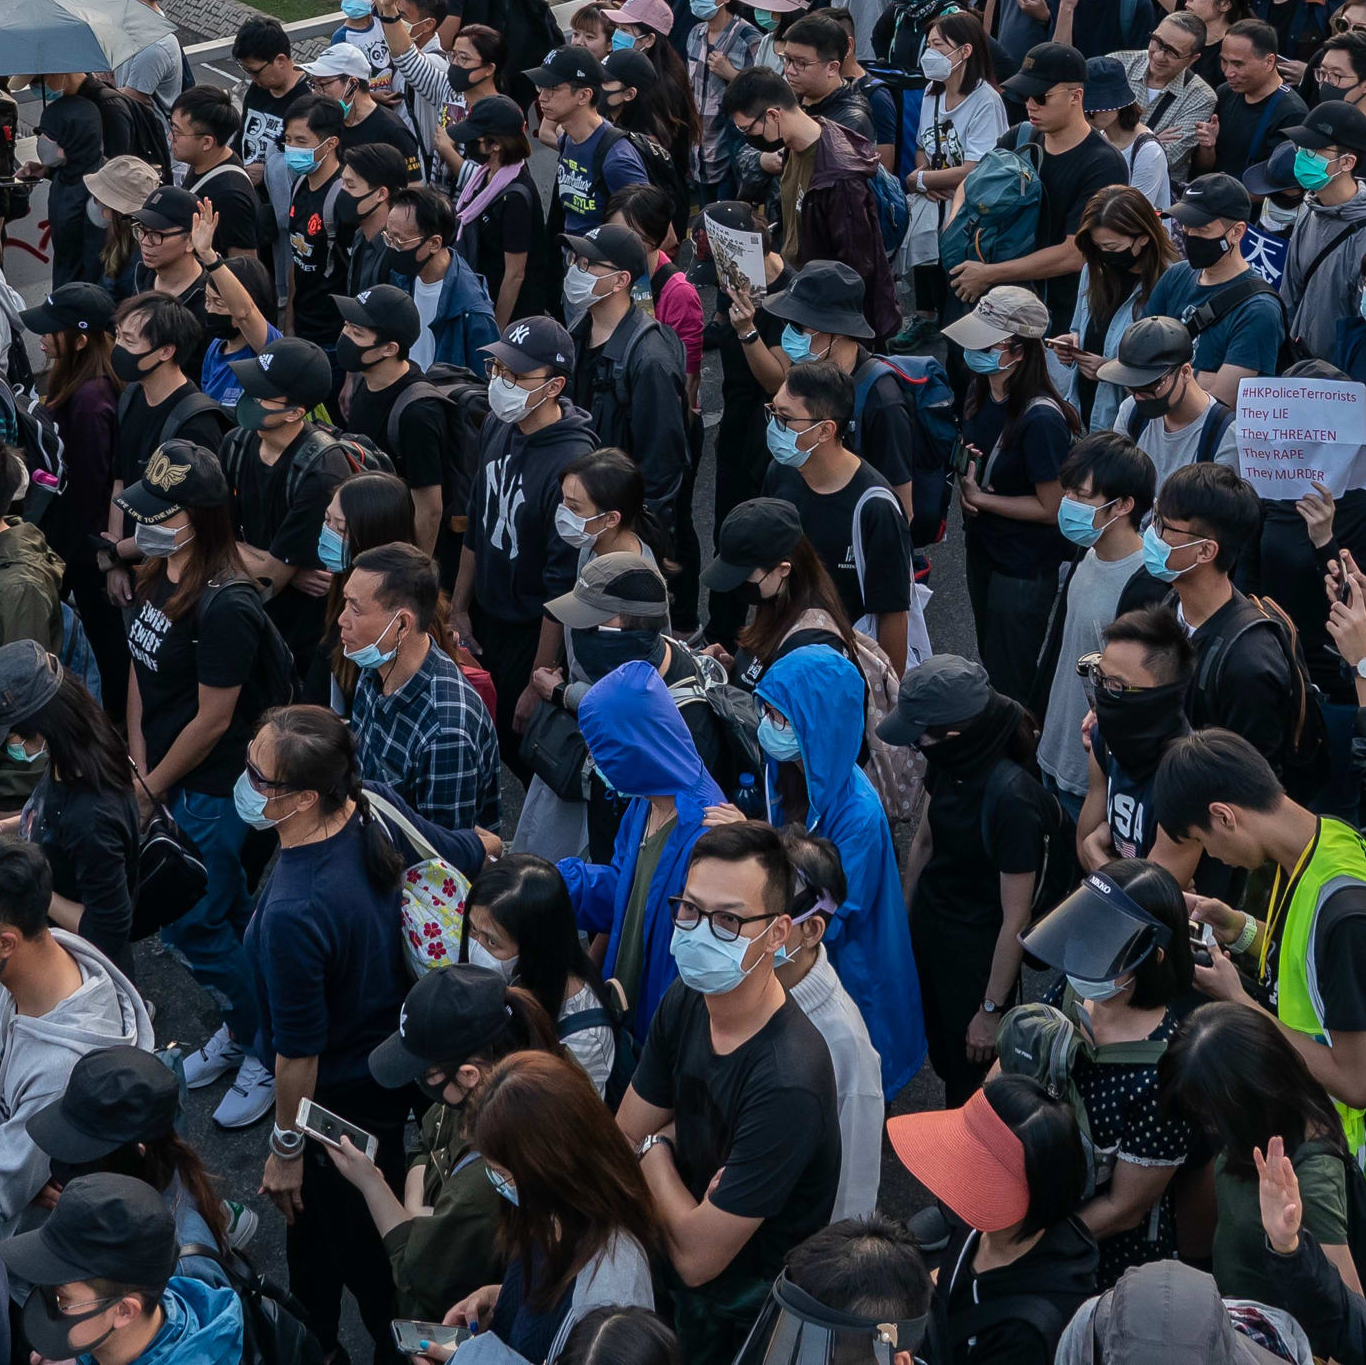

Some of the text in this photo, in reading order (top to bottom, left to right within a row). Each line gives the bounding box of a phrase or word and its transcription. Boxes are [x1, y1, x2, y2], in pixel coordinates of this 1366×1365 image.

[573, 195, 596, 212] STYLE
[509, 325, 530, 344] NY
[1242, 387, 1357, 403] #HKPoliceTerrorists
[1241, 407, 1289, 421] They LIE
[1241, 428, 1337, 442] They THREATEN
[1242, 448, 1304, 462] They RAPE
[1245, 467, 1325, 481] They MURDER
[482, 452, 526, 560] NY
[128, 507, 143, 521] LIFE
[144, 516, 154, 524] TO
